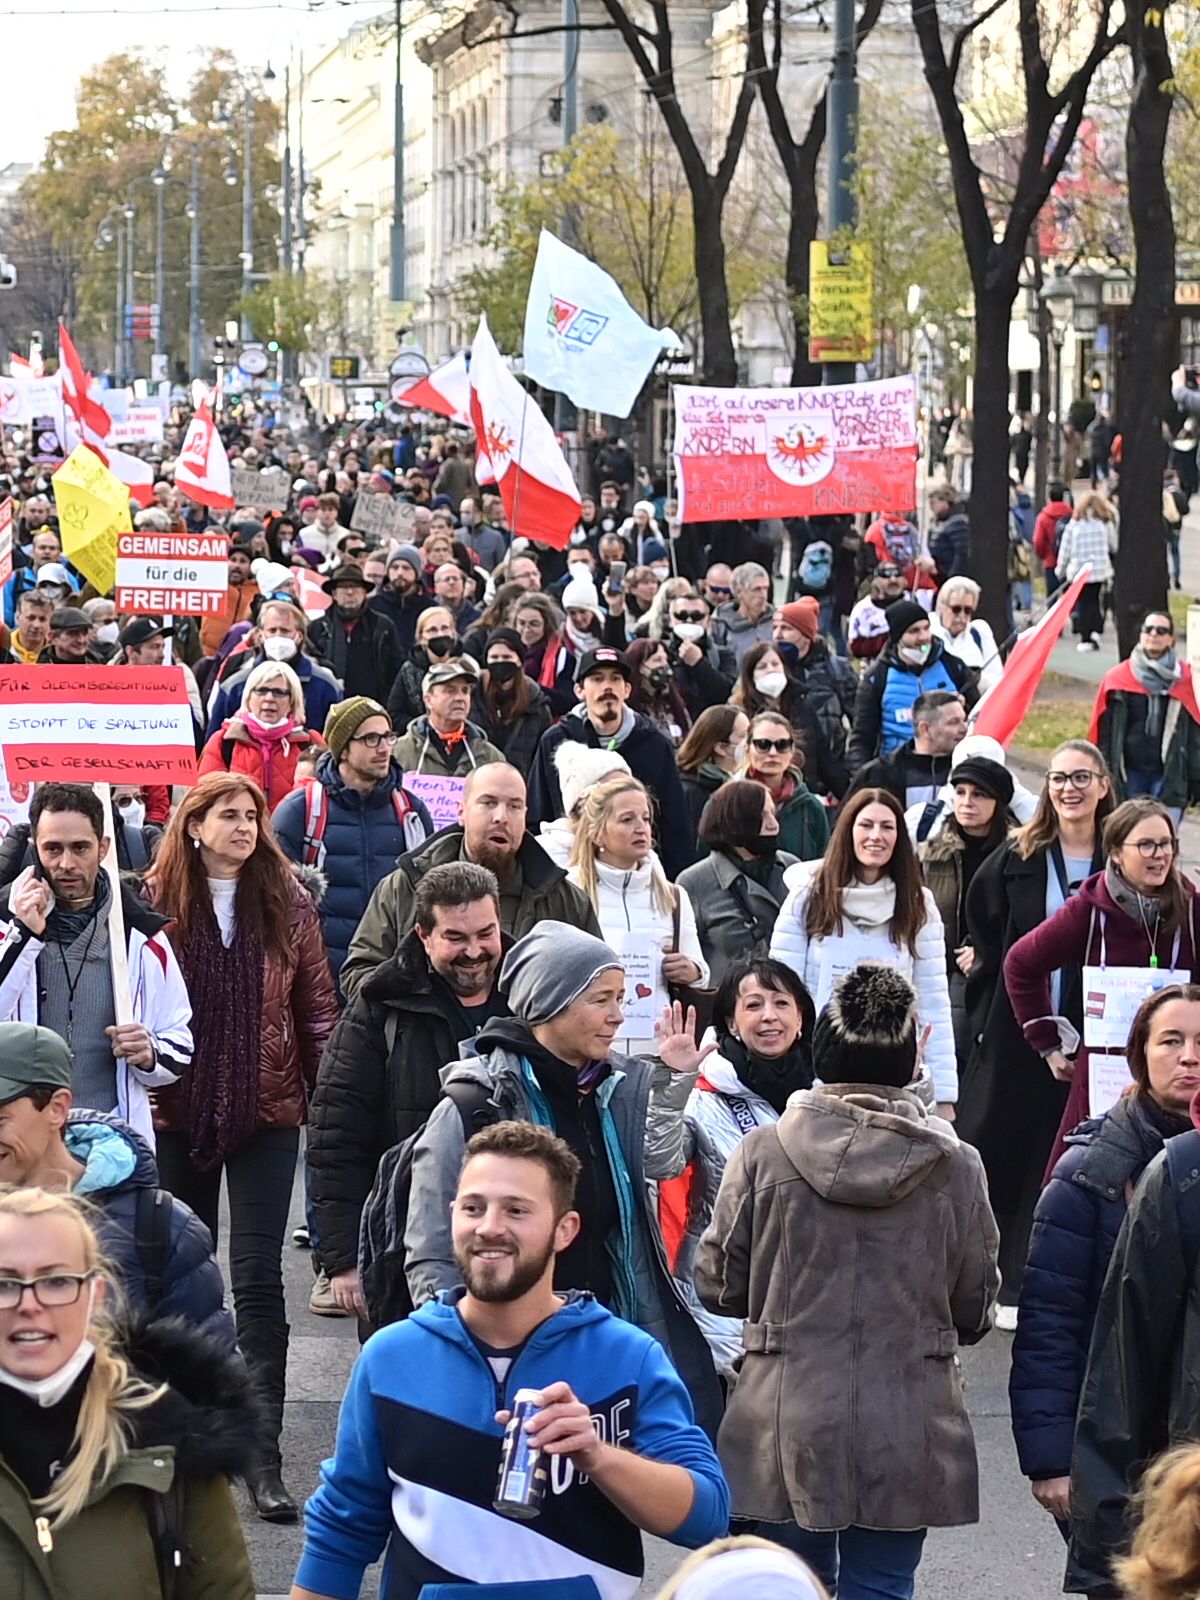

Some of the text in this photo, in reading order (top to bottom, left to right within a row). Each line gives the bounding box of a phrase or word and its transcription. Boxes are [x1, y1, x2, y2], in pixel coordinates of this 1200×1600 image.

[119, 536, 227, 557] GEMEINSAM
[146, 566, 197, 581] für die
[119, 589, 223, 612] FREIHEIT
[0, 678, 31, 692] FÜR
[8, 717, 180, 731] STOPPT DIE SPALTUNG
[15, 756, 55, 771] DER
[61, 756, 173, 771] GESELLSCHAFT
